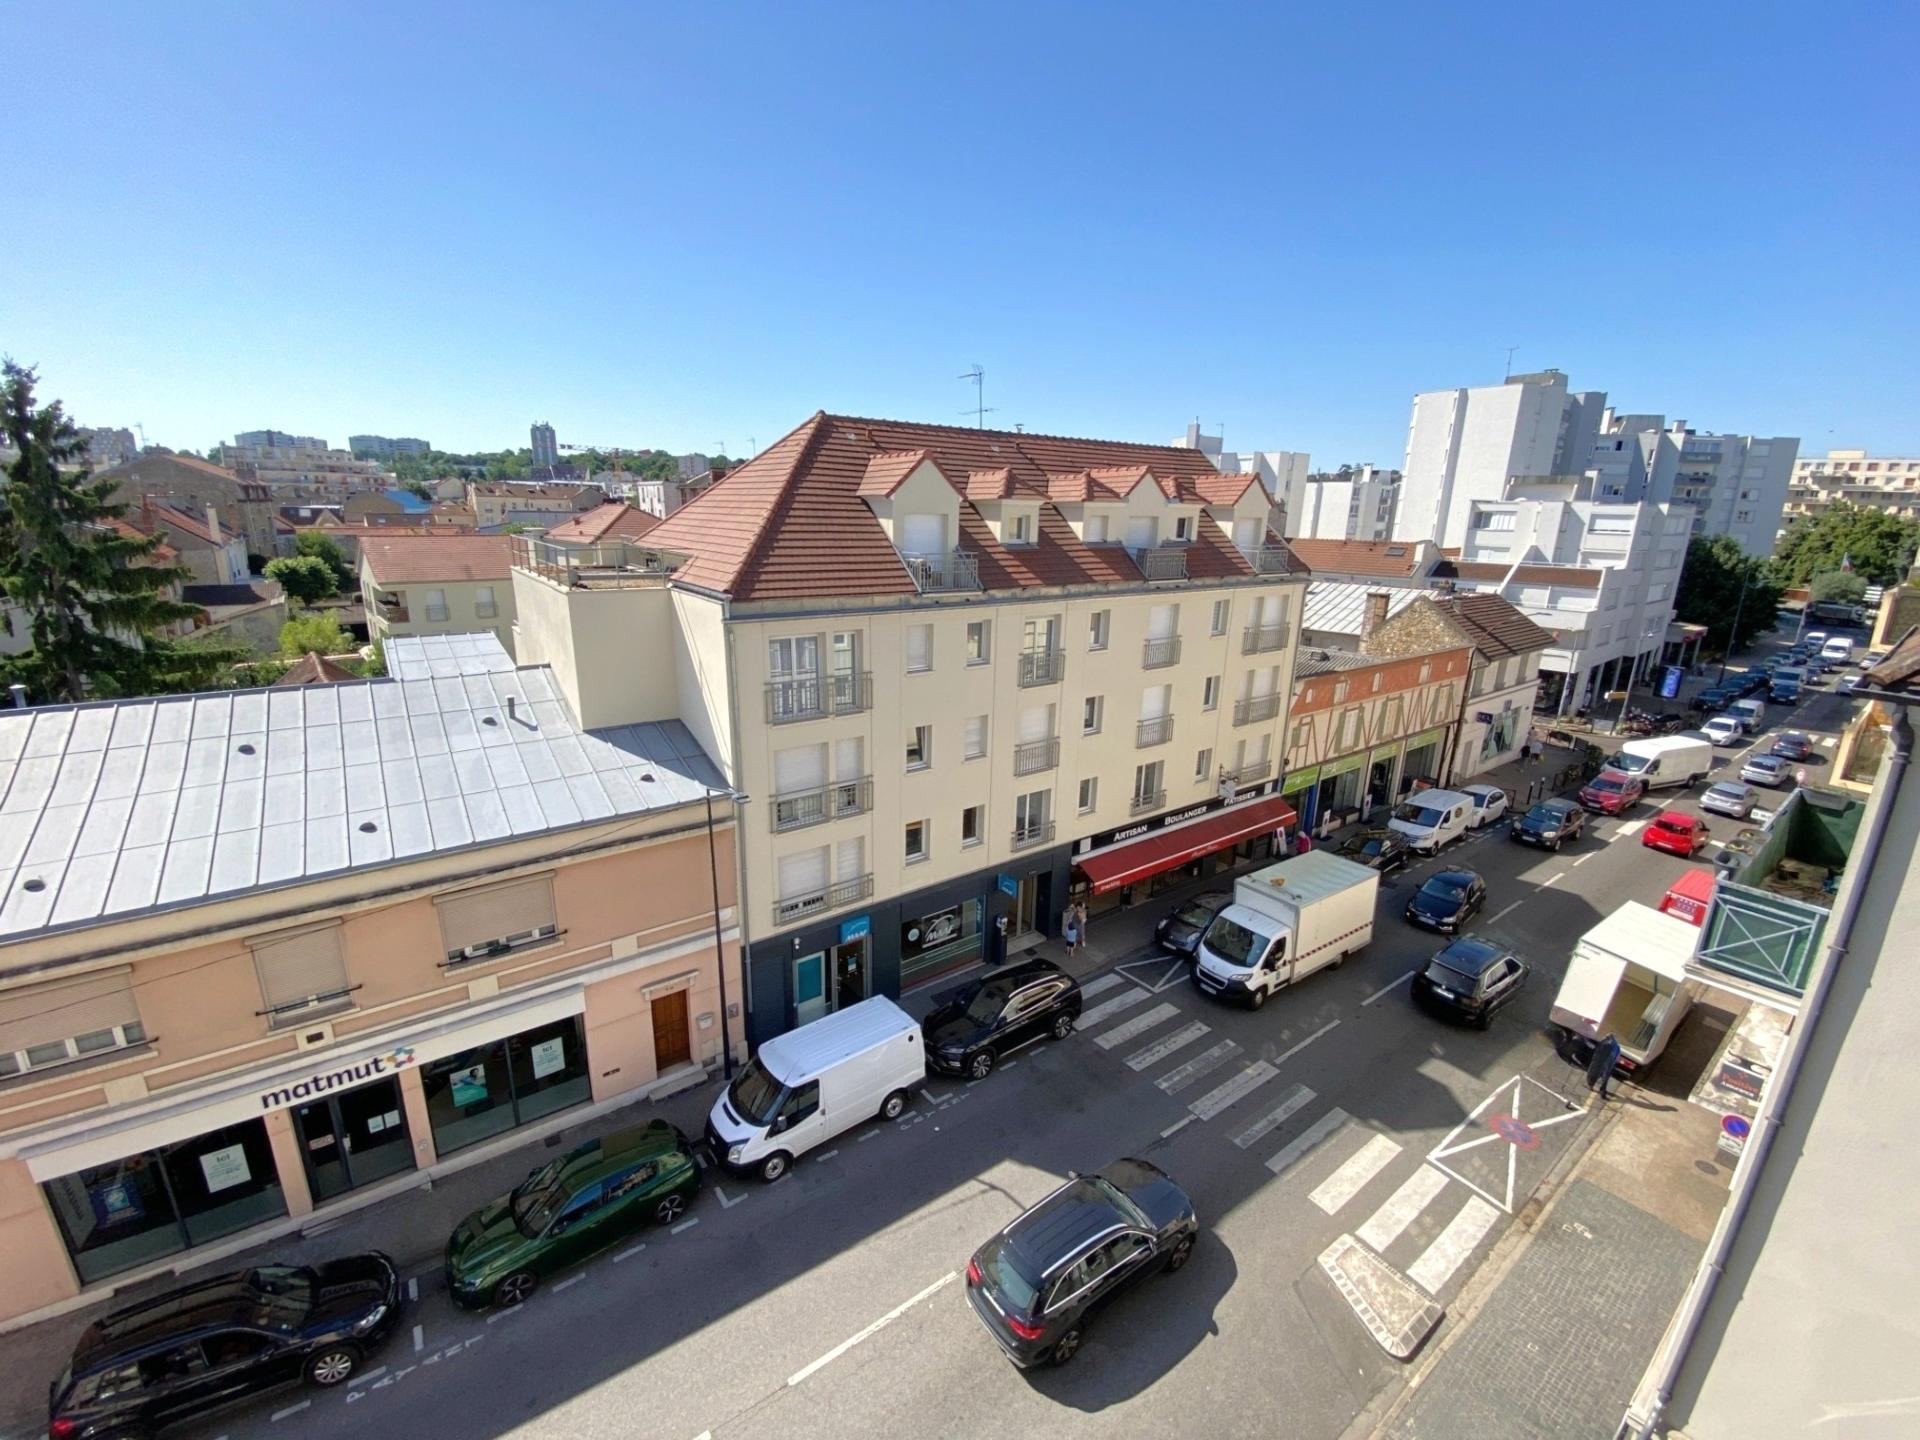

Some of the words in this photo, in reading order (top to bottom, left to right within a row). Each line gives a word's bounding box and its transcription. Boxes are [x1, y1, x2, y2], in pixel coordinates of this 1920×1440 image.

[1113, 824, 1148, 842] ARTISAN
[1164, 805, 1208, 826] BOULANGER
[261, 1056, 387, 1109] matmut
[346, 1334, 485, 1404] PAYANT
